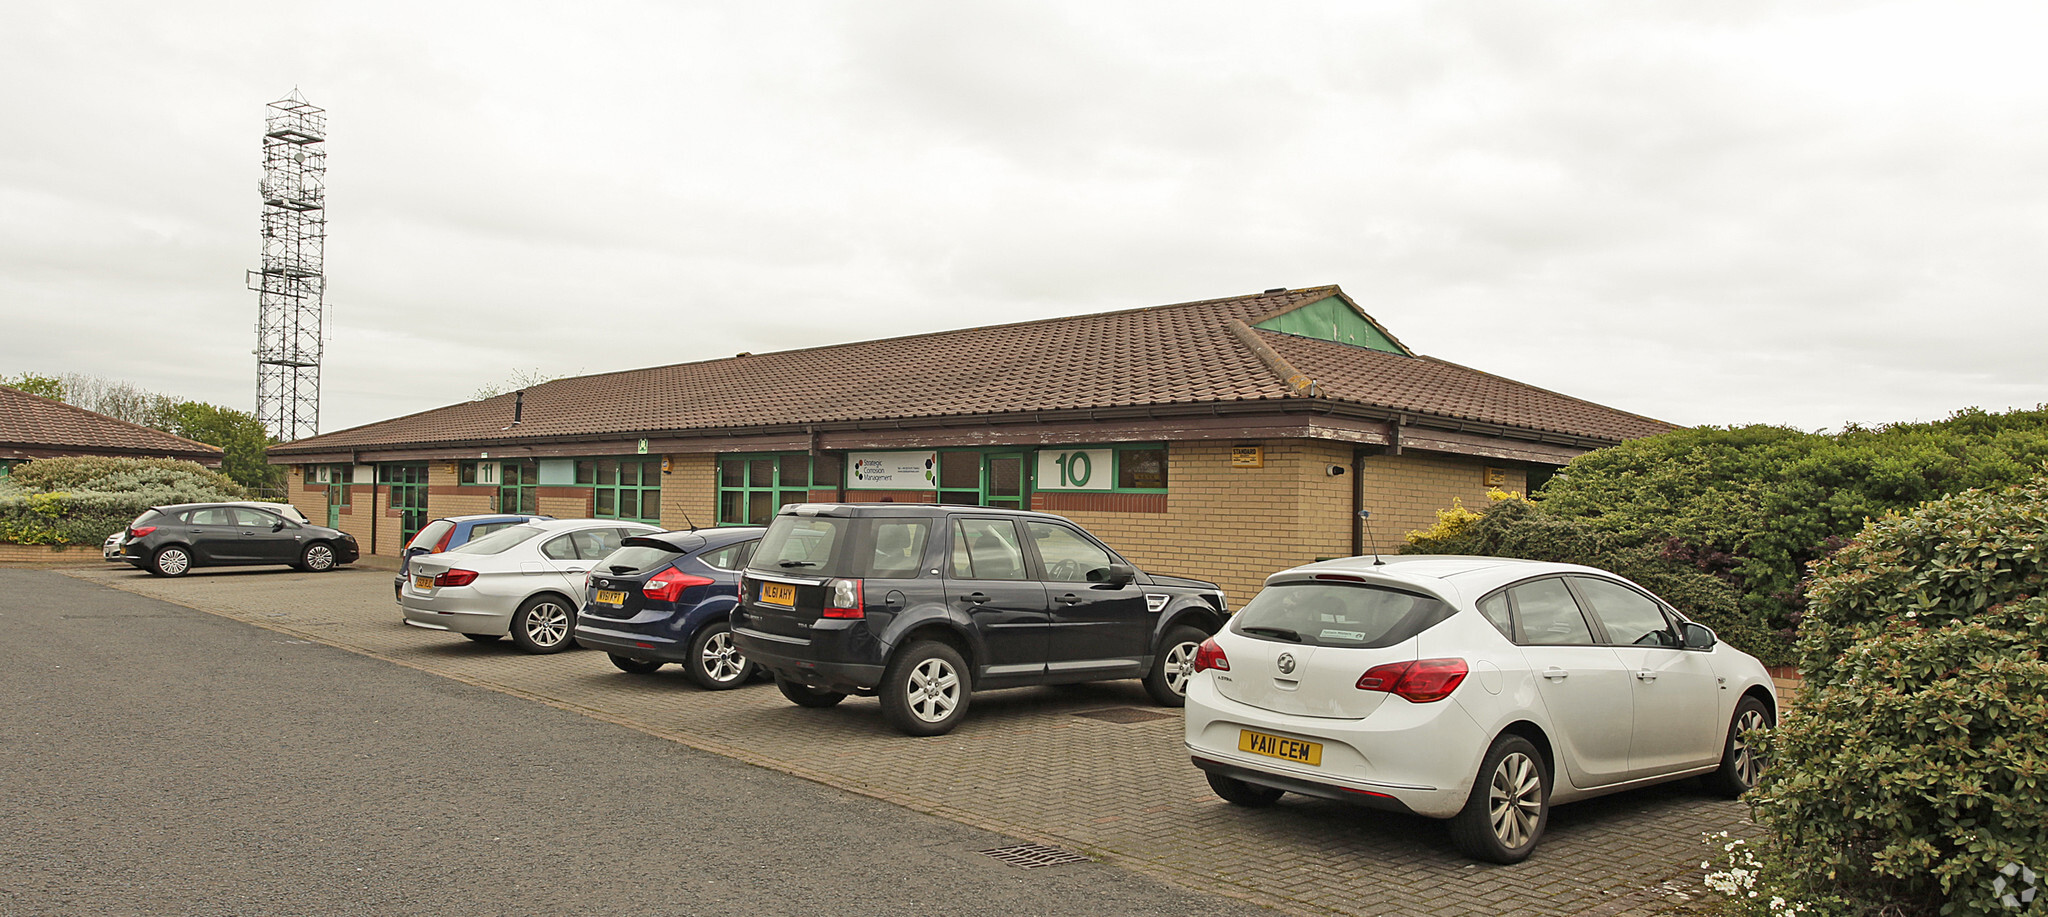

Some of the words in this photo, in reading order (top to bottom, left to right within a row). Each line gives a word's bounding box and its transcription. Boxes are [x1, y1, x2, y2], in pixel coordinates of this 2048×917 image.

[863, 459, 883, 468] Strategic
[863, 467, 885, 475] Corrosion
[1055, 451, 1092, 487] 10
[320, 466, 327, 482] 12
[482, 463, 493, 483] 11
[863, 474, 893, 482] Management
[765, 585, 778, 599] NL61
[779, 587, 793, 601] AHY
[1250, 733, 1277, 755] VA11
[1279, 739, 1311, 761] CEM
